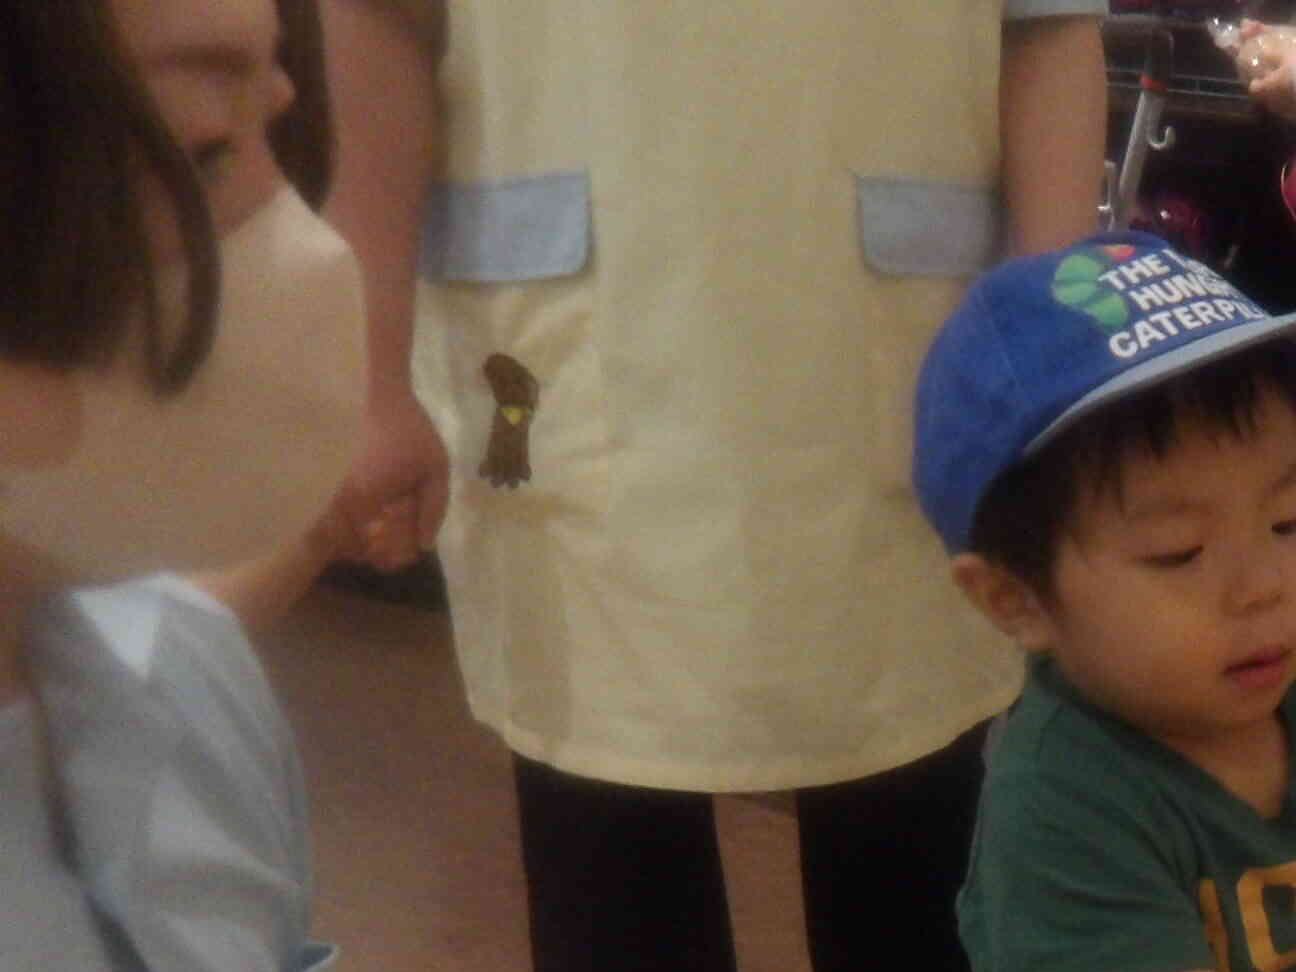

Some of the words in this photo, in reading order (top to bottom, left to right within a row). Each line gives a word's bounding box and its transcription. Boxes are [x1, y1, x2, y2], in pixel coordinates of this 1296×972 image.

[1098, 253, 1171, 291] THE
[1128, 270, 1246, 311] HUNG
[1108, 298, 1266, 358] CATERPIL
